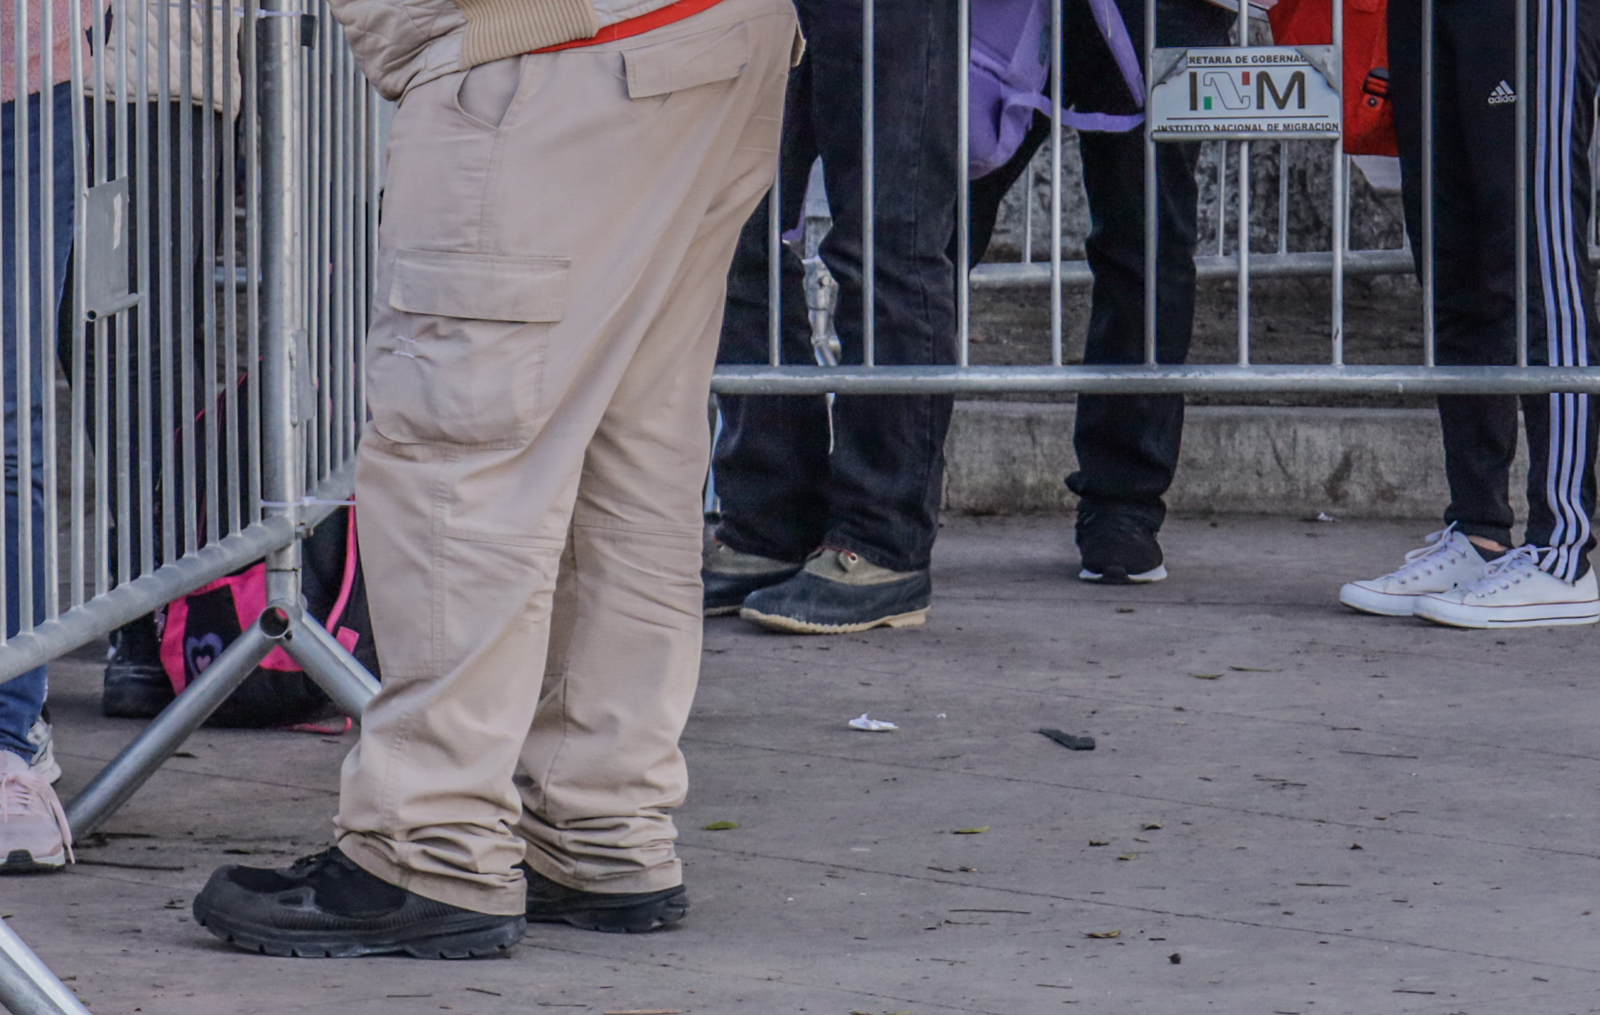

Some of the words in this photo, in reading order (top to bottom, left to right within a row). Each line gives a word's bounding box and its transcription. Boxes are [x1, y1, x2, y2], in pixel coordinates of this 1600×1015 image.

[1186, 55, 1232, 64] RETARIA
[1235, 55, 1248, 64] DE
[1189, 70, 1305, 111] INM
[1487, 94, 1517, 105] adida
[1267, 123, 1280, 131] DE
